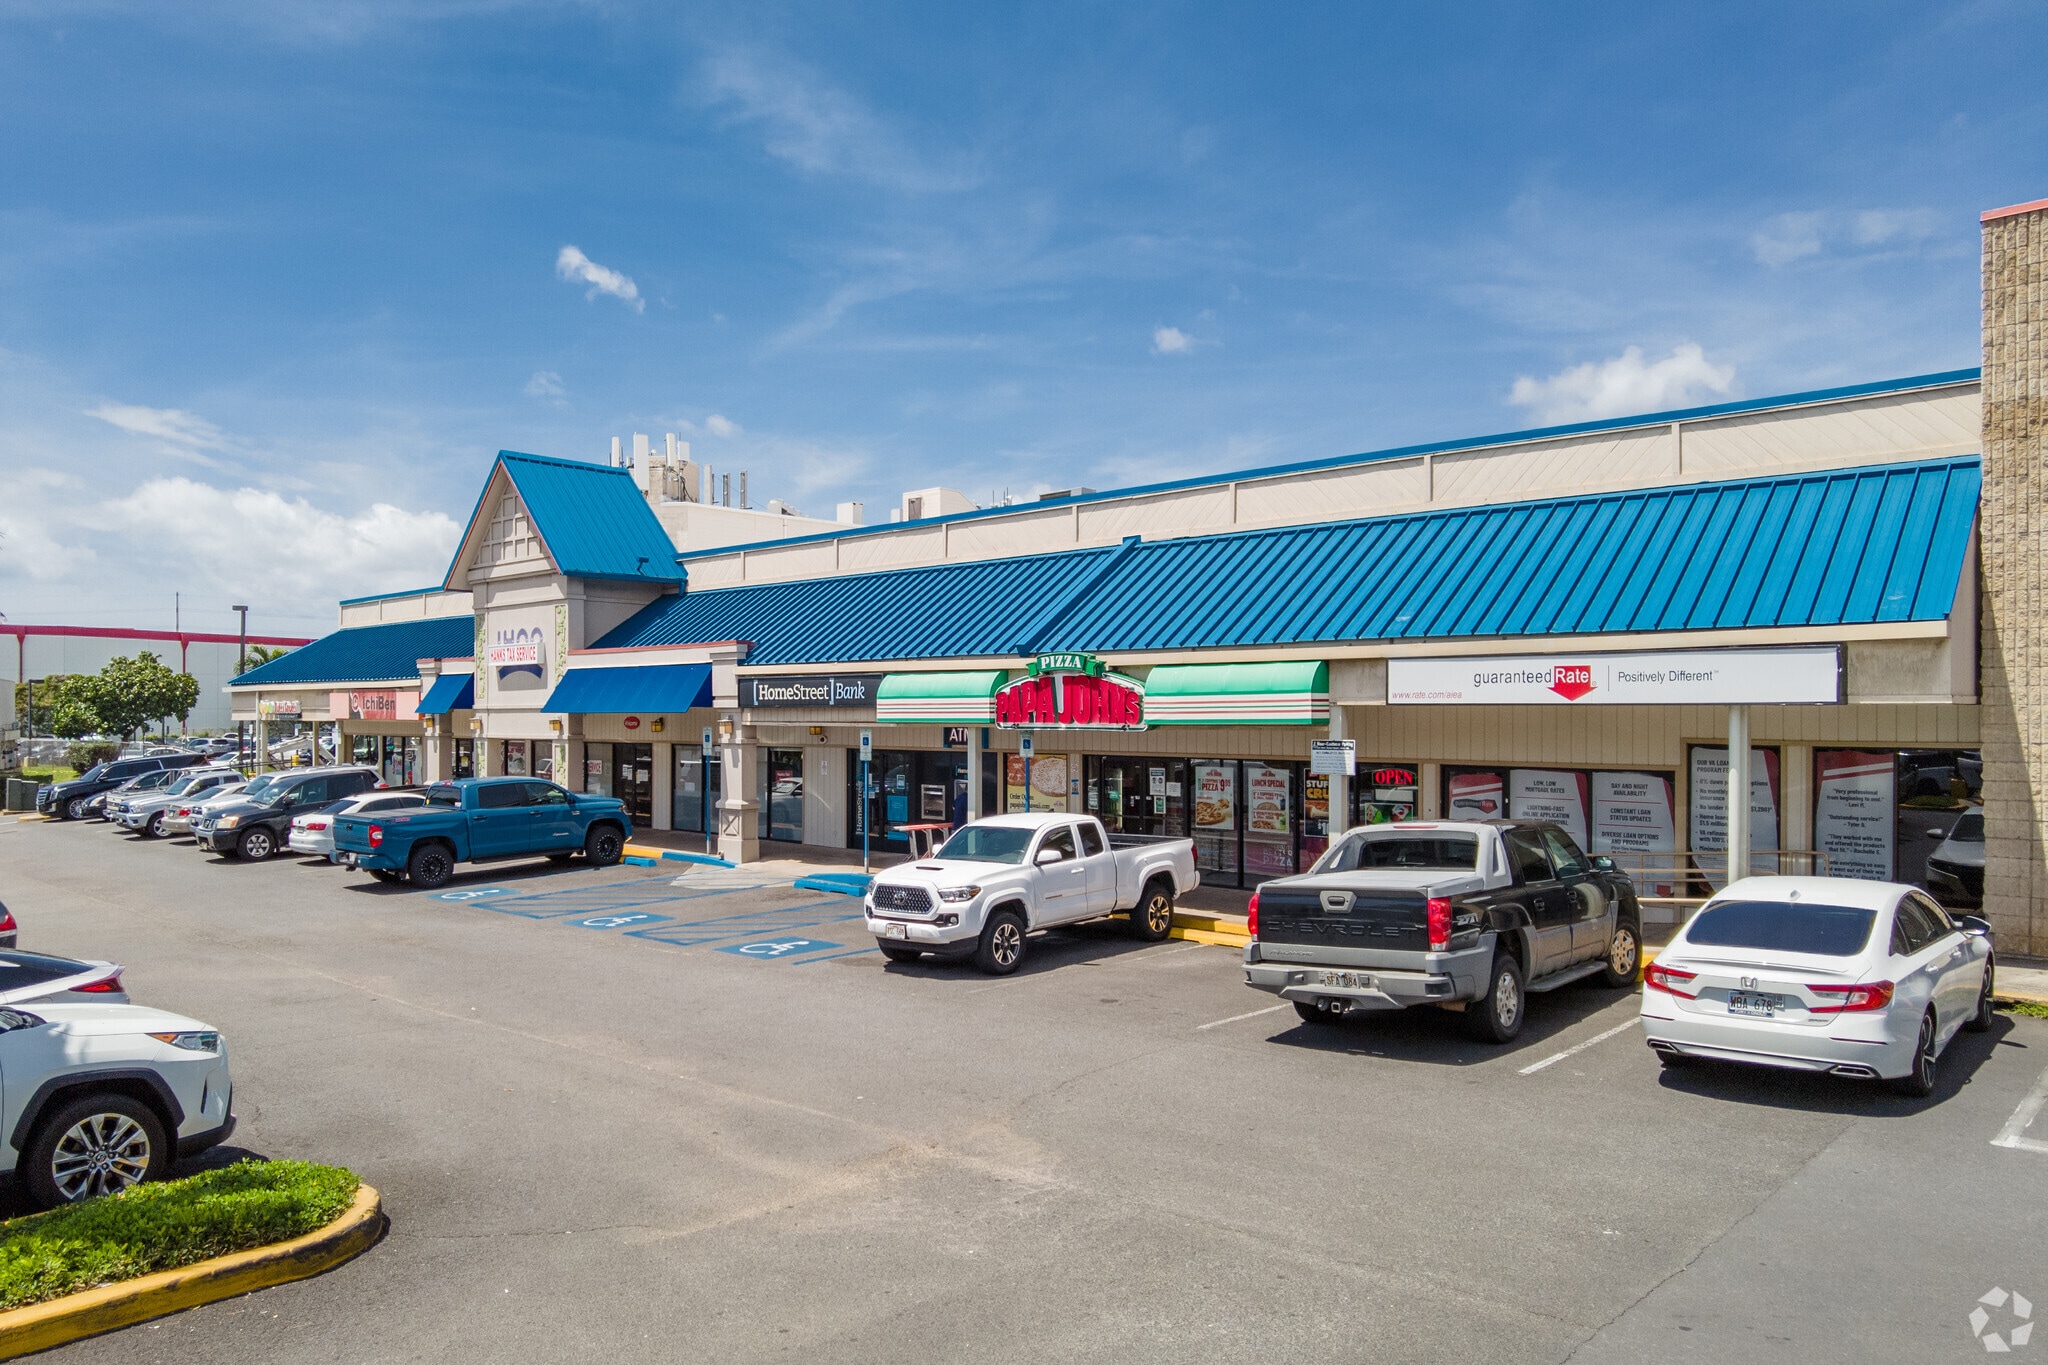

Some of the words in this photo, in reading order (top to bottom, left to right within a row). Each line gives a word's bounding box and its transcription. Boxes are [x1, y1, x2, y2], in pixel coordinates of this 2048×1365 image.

[490, 648, 506, 662] HANKS
[506, 648, 514, 662] TAX
[516, 646, 536, 661] SERVICE
[1040, 655, 1082, 668] PIZZA
[1474, 668, 1552, 688] guaranteed
[1555, 668, 1590, 684] Rate
[1618, 671, 1666, 684] Positively
[1668, 670, 1714, 682] Different
[836, 681, 865, 699] Bank
[1392, 690, 1462, 699] www.rate.com/aiea
[362, 696, 395, 710] IchiBen
[996, 676, 1055, 724] PAPA
[1267, 780, 1286, 788] SPECIAL
[1375, 769, 1413, 785] OPEN
[1267, 921, 1418, 936] CHEVROLET
[1730, 996, 1748, 1009] WBA
[1754, 998, 1772, 1011] 678
